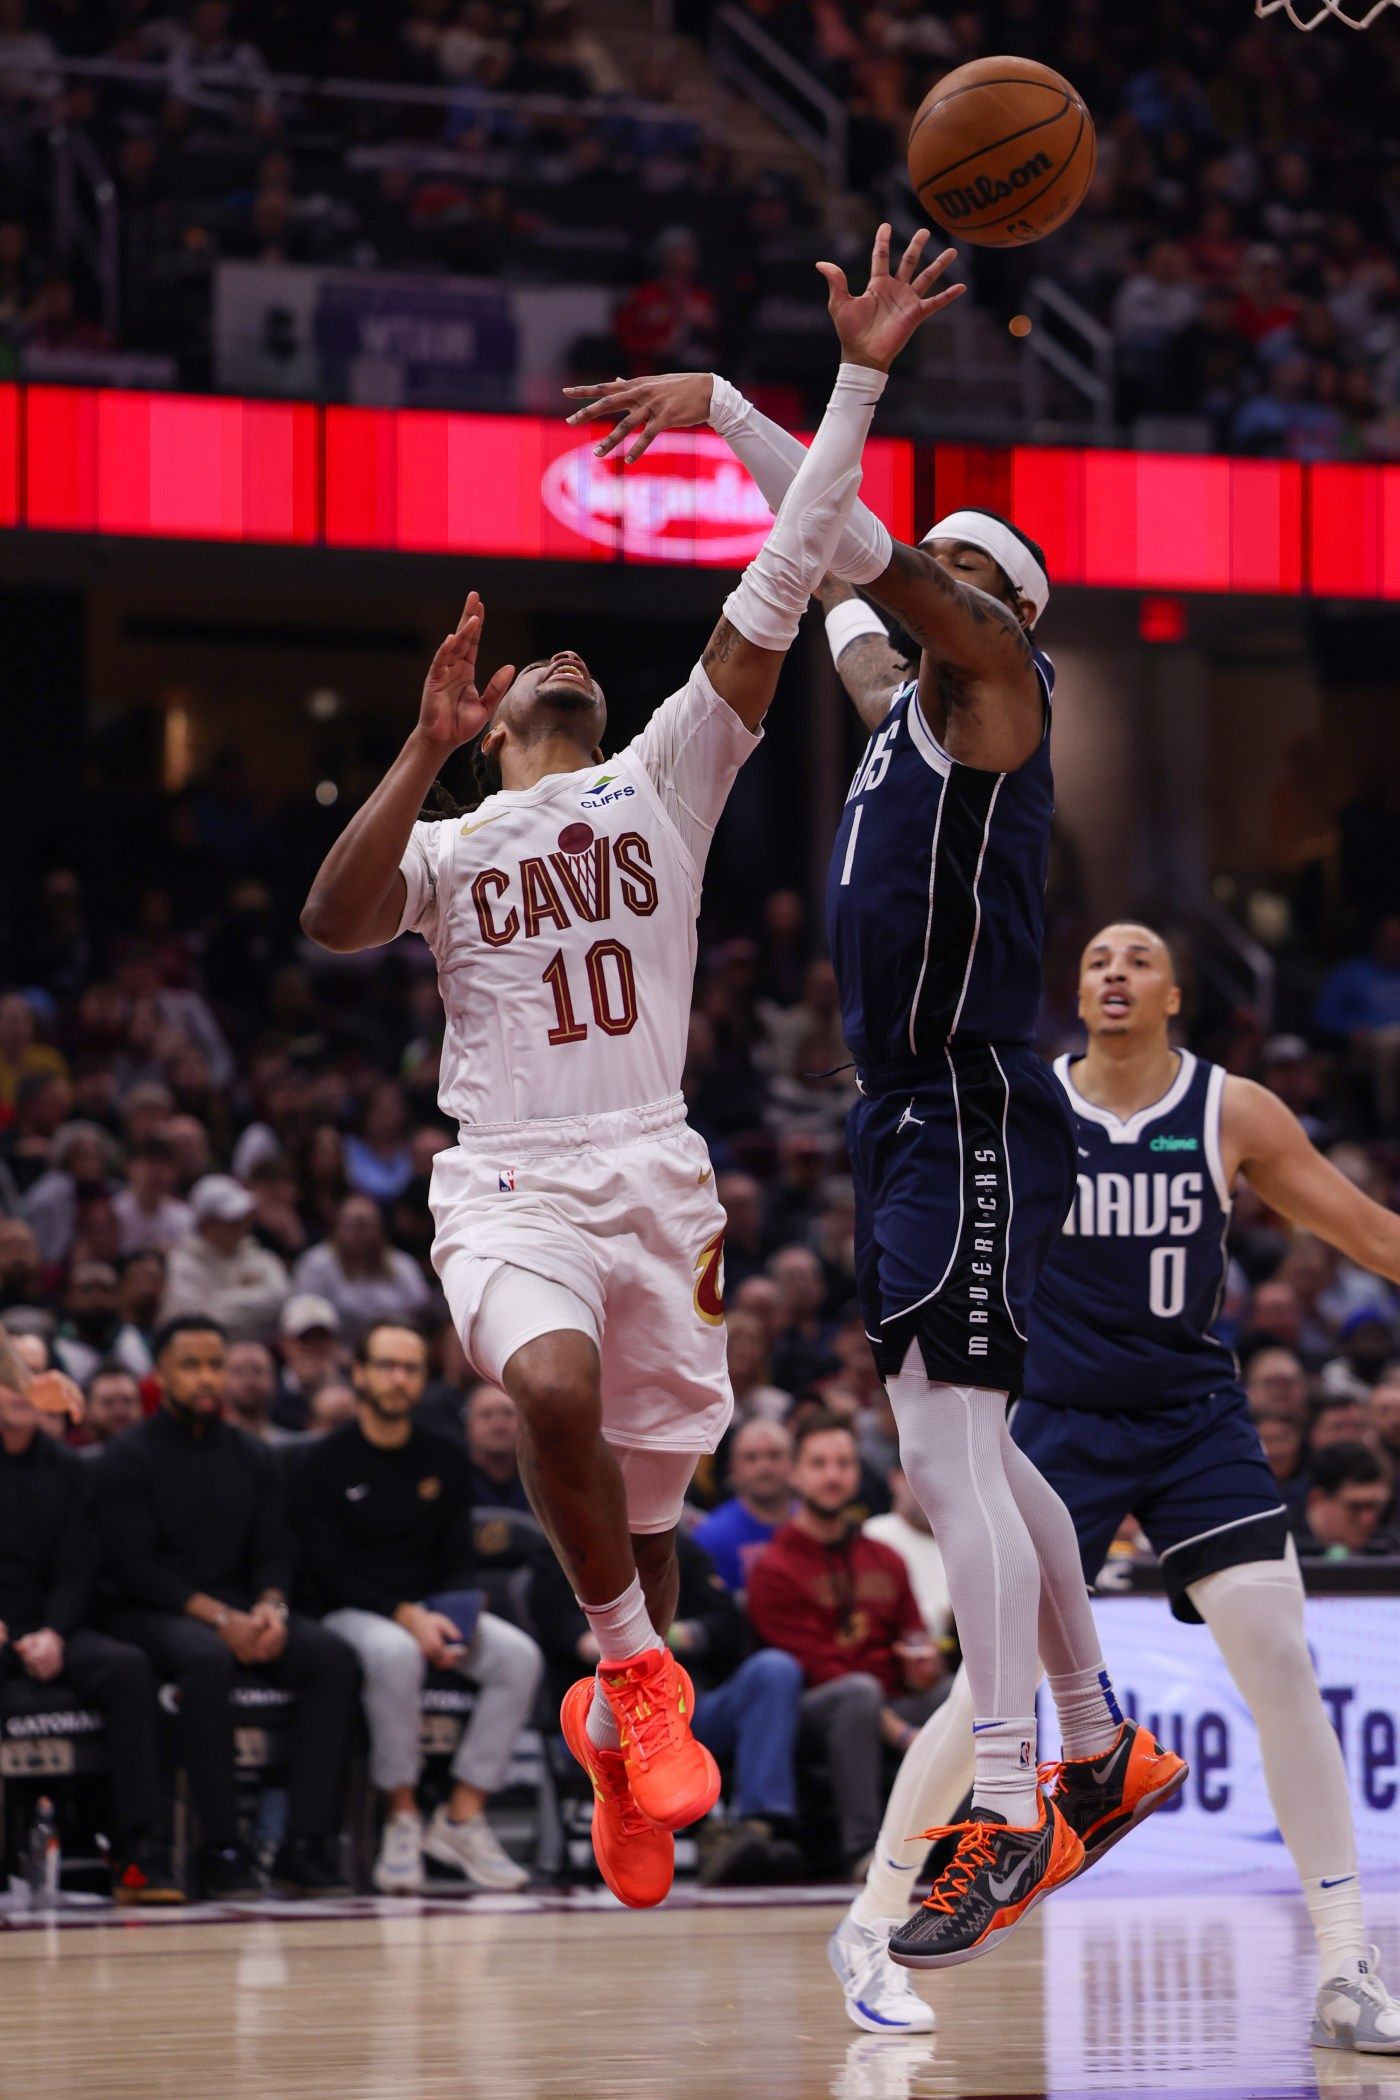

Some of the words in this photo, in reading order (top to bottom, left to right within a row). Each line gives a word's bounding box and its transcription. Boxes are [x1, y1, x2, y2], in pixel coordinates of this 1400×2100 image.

[934, 152, 1053, 219] Wilson
[580, 786, 635, 809] CLIFFS
[470, 830, 659, 948] CAVS
[541, 938, 639, 1046] 10
[1149, 1134, 1199, 1152] chime
[968, 1149, 998, 1356] MAVERICKS
[1149, 1246, 1187, 1319] 0
